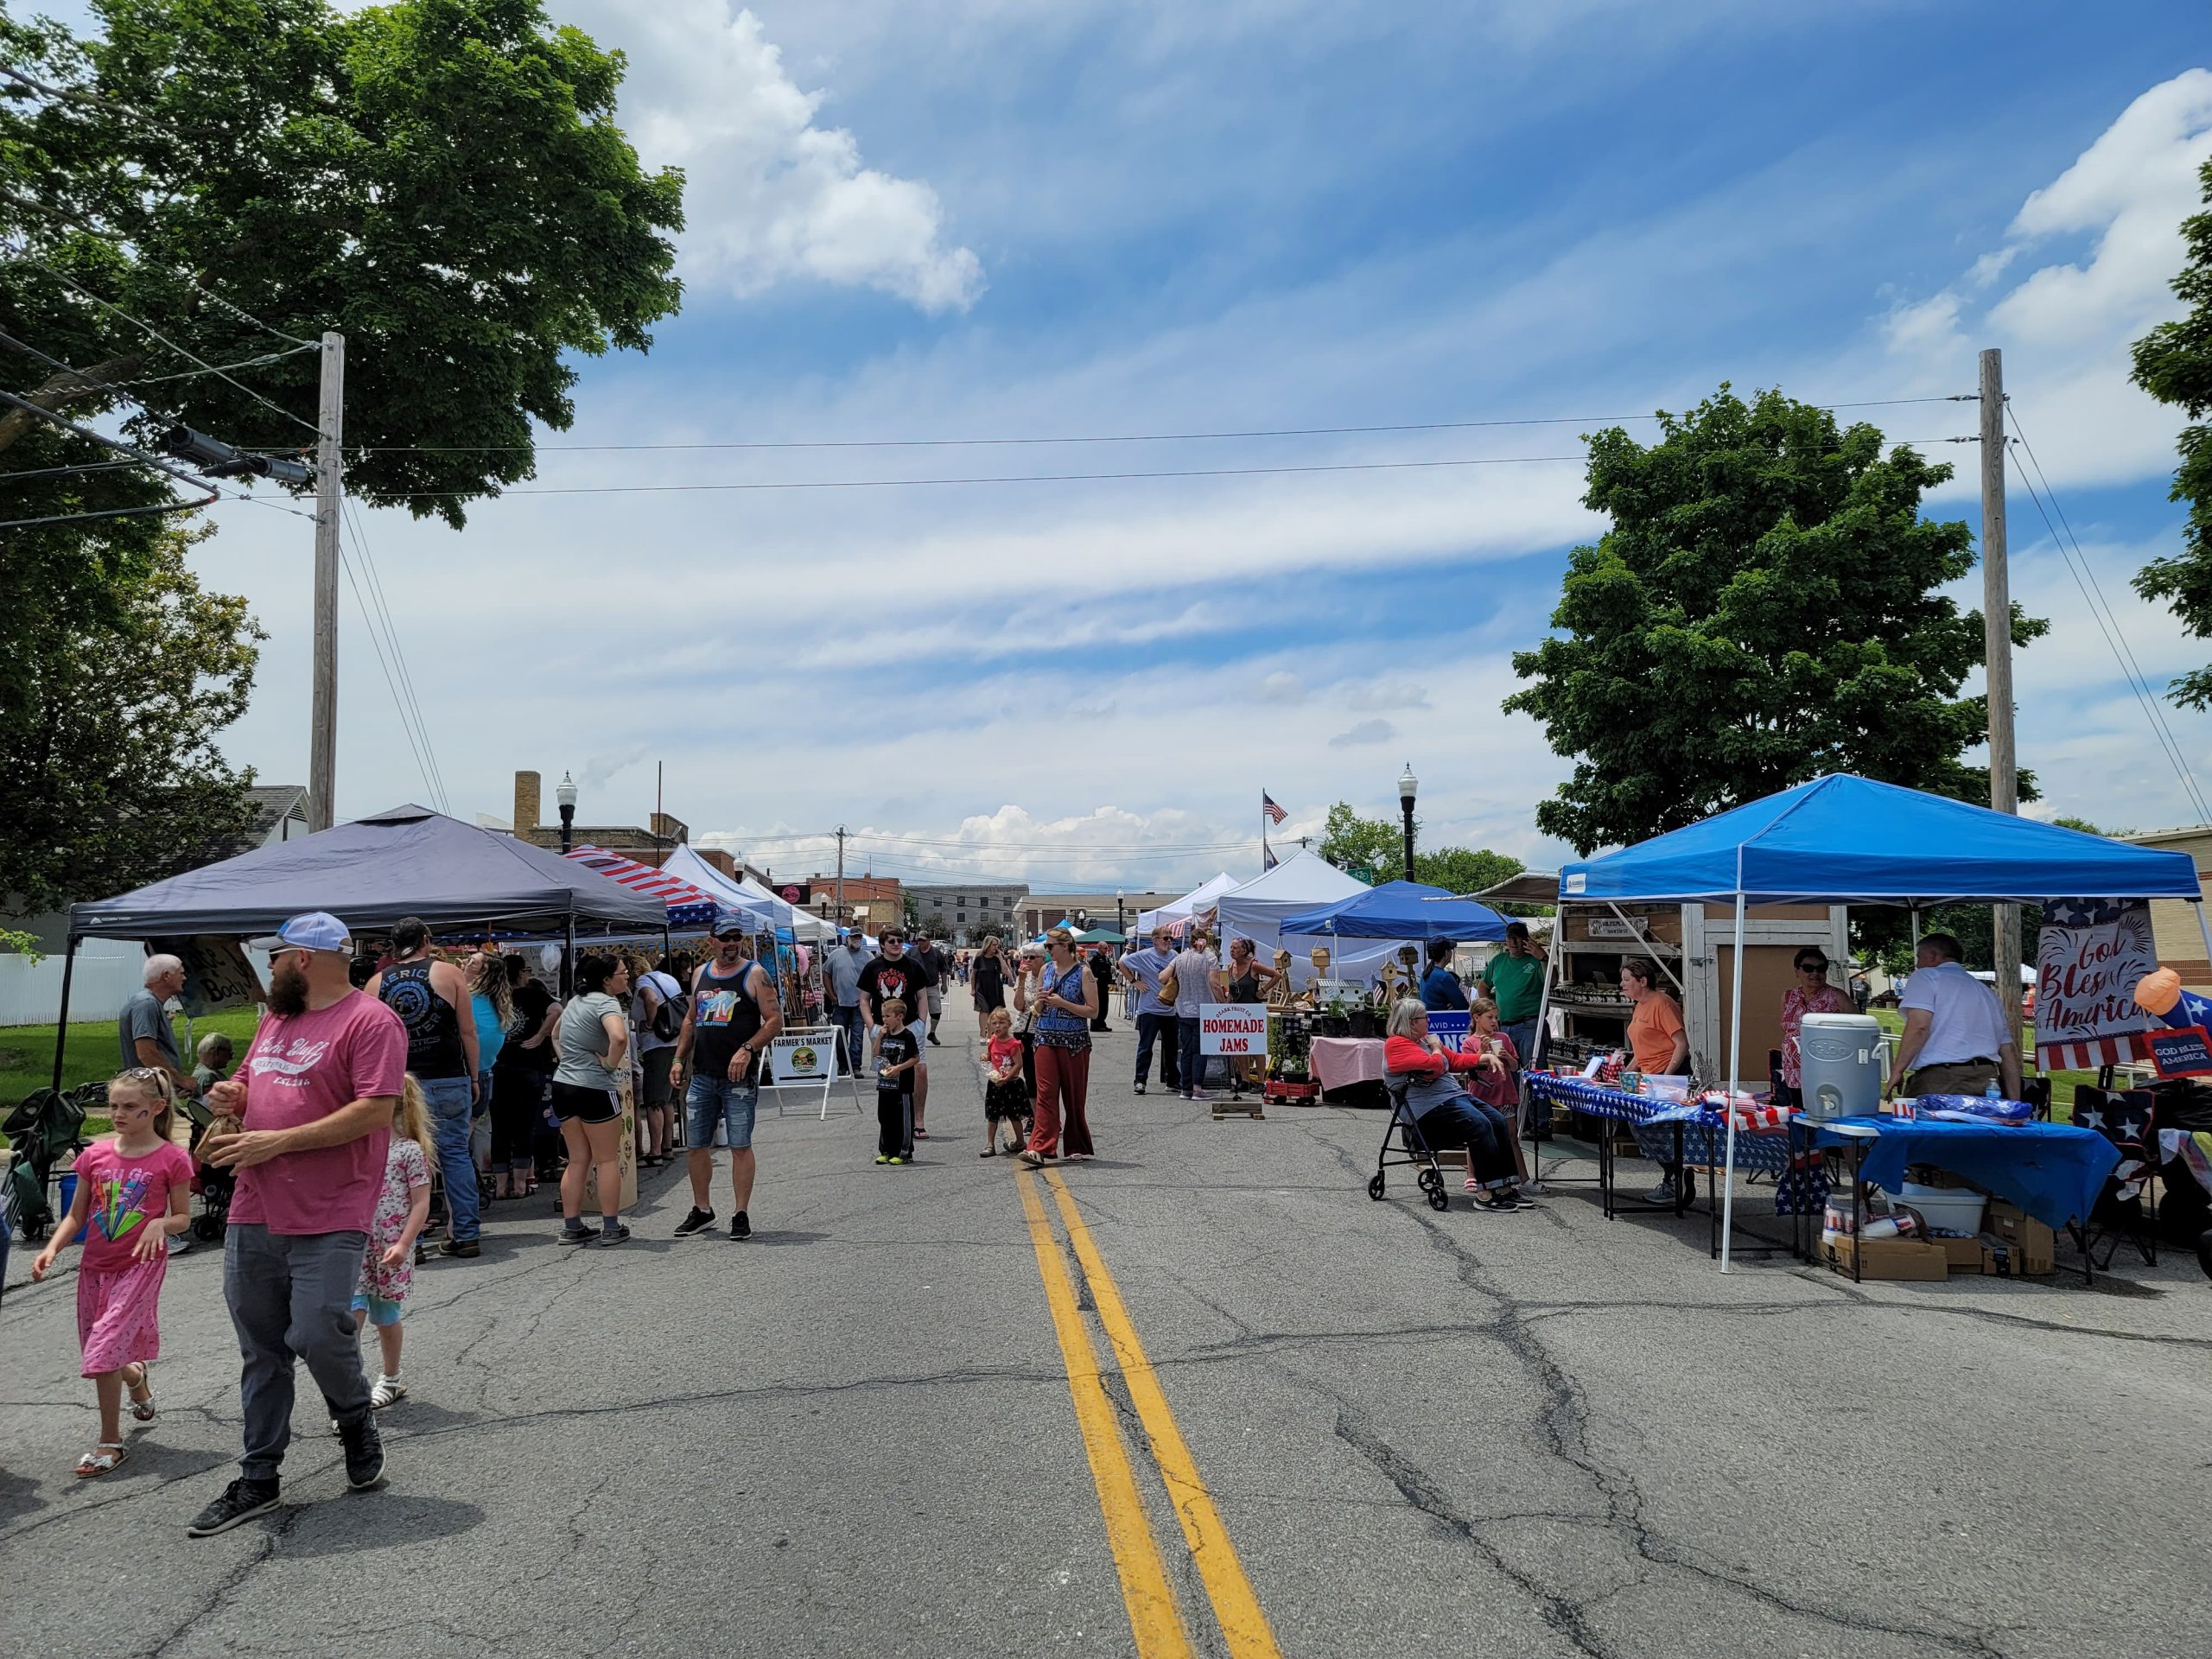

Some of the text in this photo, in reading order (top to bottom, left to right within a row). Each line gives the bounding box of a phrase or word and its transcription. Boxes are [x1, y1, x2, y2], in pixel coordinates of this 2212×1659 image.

[2079, 923, 2126, 969] God
[199, 977, 250, 1002] Body
[1216, 1007, 1231, 1018] OZARK
[1203, 1020, 1264, 1033] HOMEMADE
[774, 1037, 832, 1047] FARMER'S MARKET
[1220, 1039, 1249, 1052] JAMS
[2178, 1044, 2207, 1053] BLESS
[286, 1038, 330, 1064] Bluff
[2163, 1052, 2208, 1065] AMERICA
